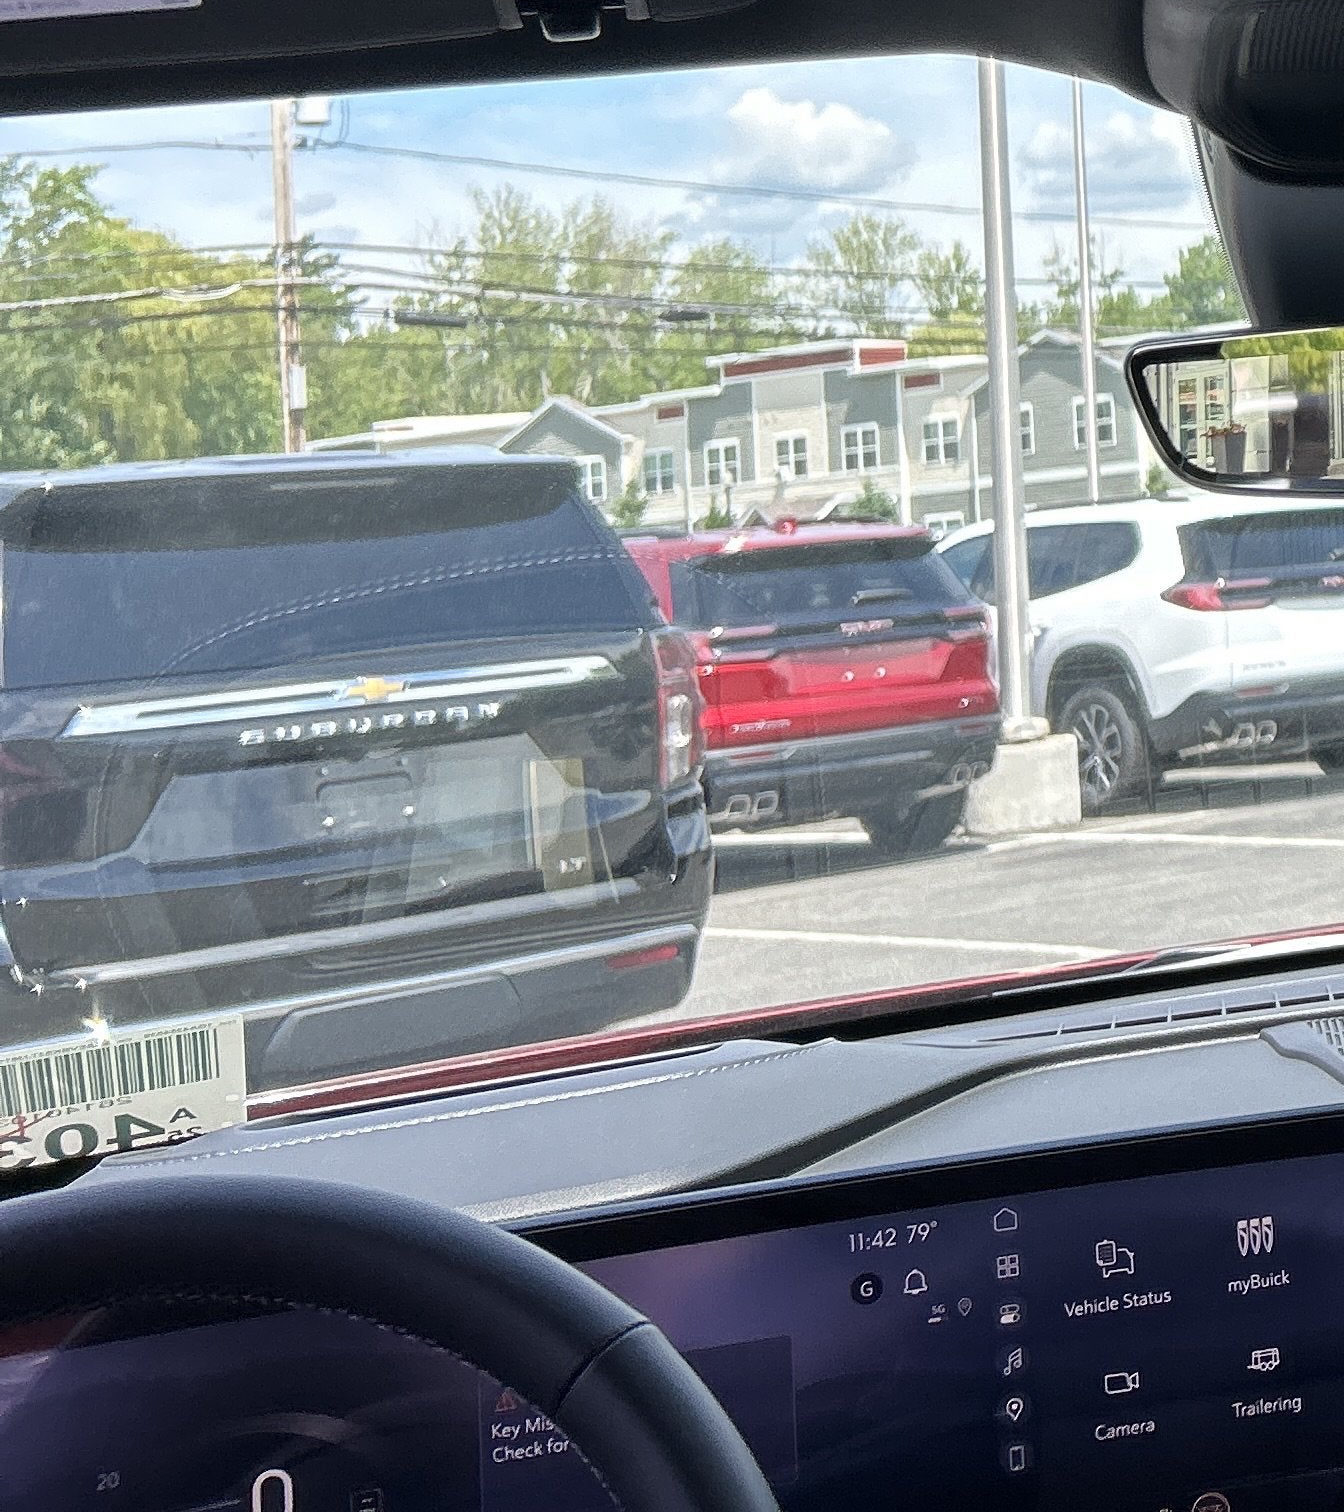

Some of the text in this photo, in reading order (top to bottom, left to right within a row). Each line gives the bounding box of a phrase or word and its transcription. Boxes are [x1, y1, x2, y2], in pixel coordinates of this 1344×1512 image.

[237, 701, 500, 746] SUBURBAN
[848, 1220, 938, 1253] 11:42 79°
[860, 1281, 874, 1298] G
[1228, 1270, 1290, 1294] myBuick
[1064, 1289, 1172, 1318] Vehicle Status
[1232, 1394, 1302, 1419] Trailering
[491, 1422, 521, 1441] Key
[1095, 1417, 1155, 1441] Camera
[492, 1437, 570, 1463] Check for
